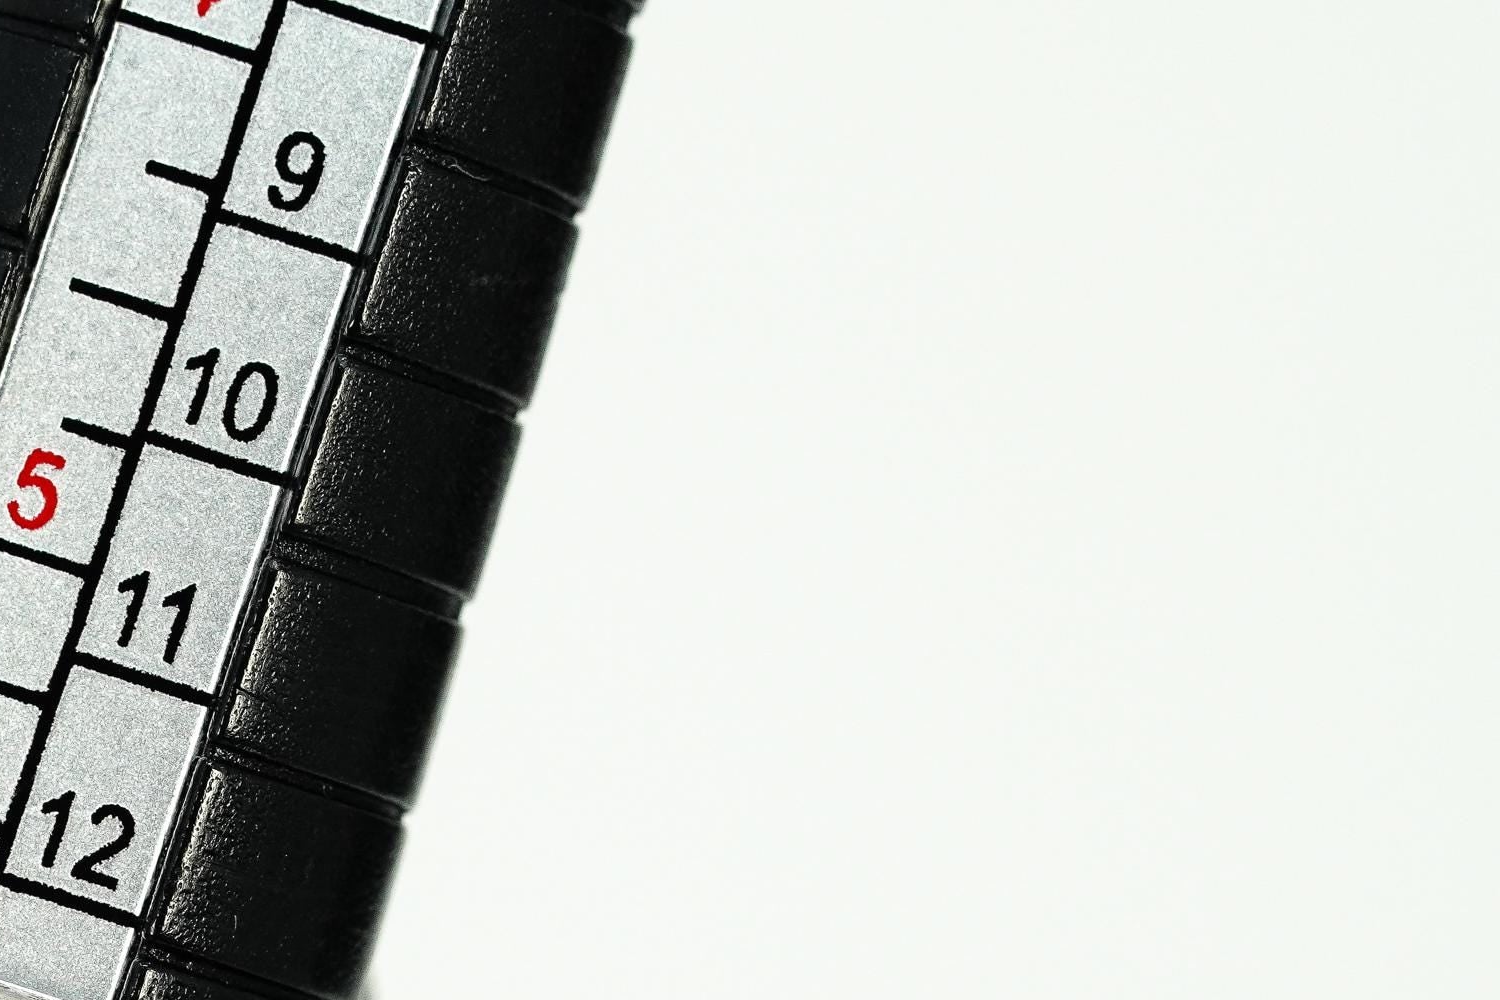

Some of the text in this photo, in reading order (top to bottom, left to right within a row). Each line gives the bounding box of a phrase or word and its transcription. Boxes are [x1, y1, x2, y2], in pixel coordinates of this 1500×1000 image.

[267, 131, 327, 213] 9
[184, 347, 280, 445] 10
[7, 447, 67, 531] 5
[116, 570, 198, 665] 11
[40, 790, 136, 892] 12
